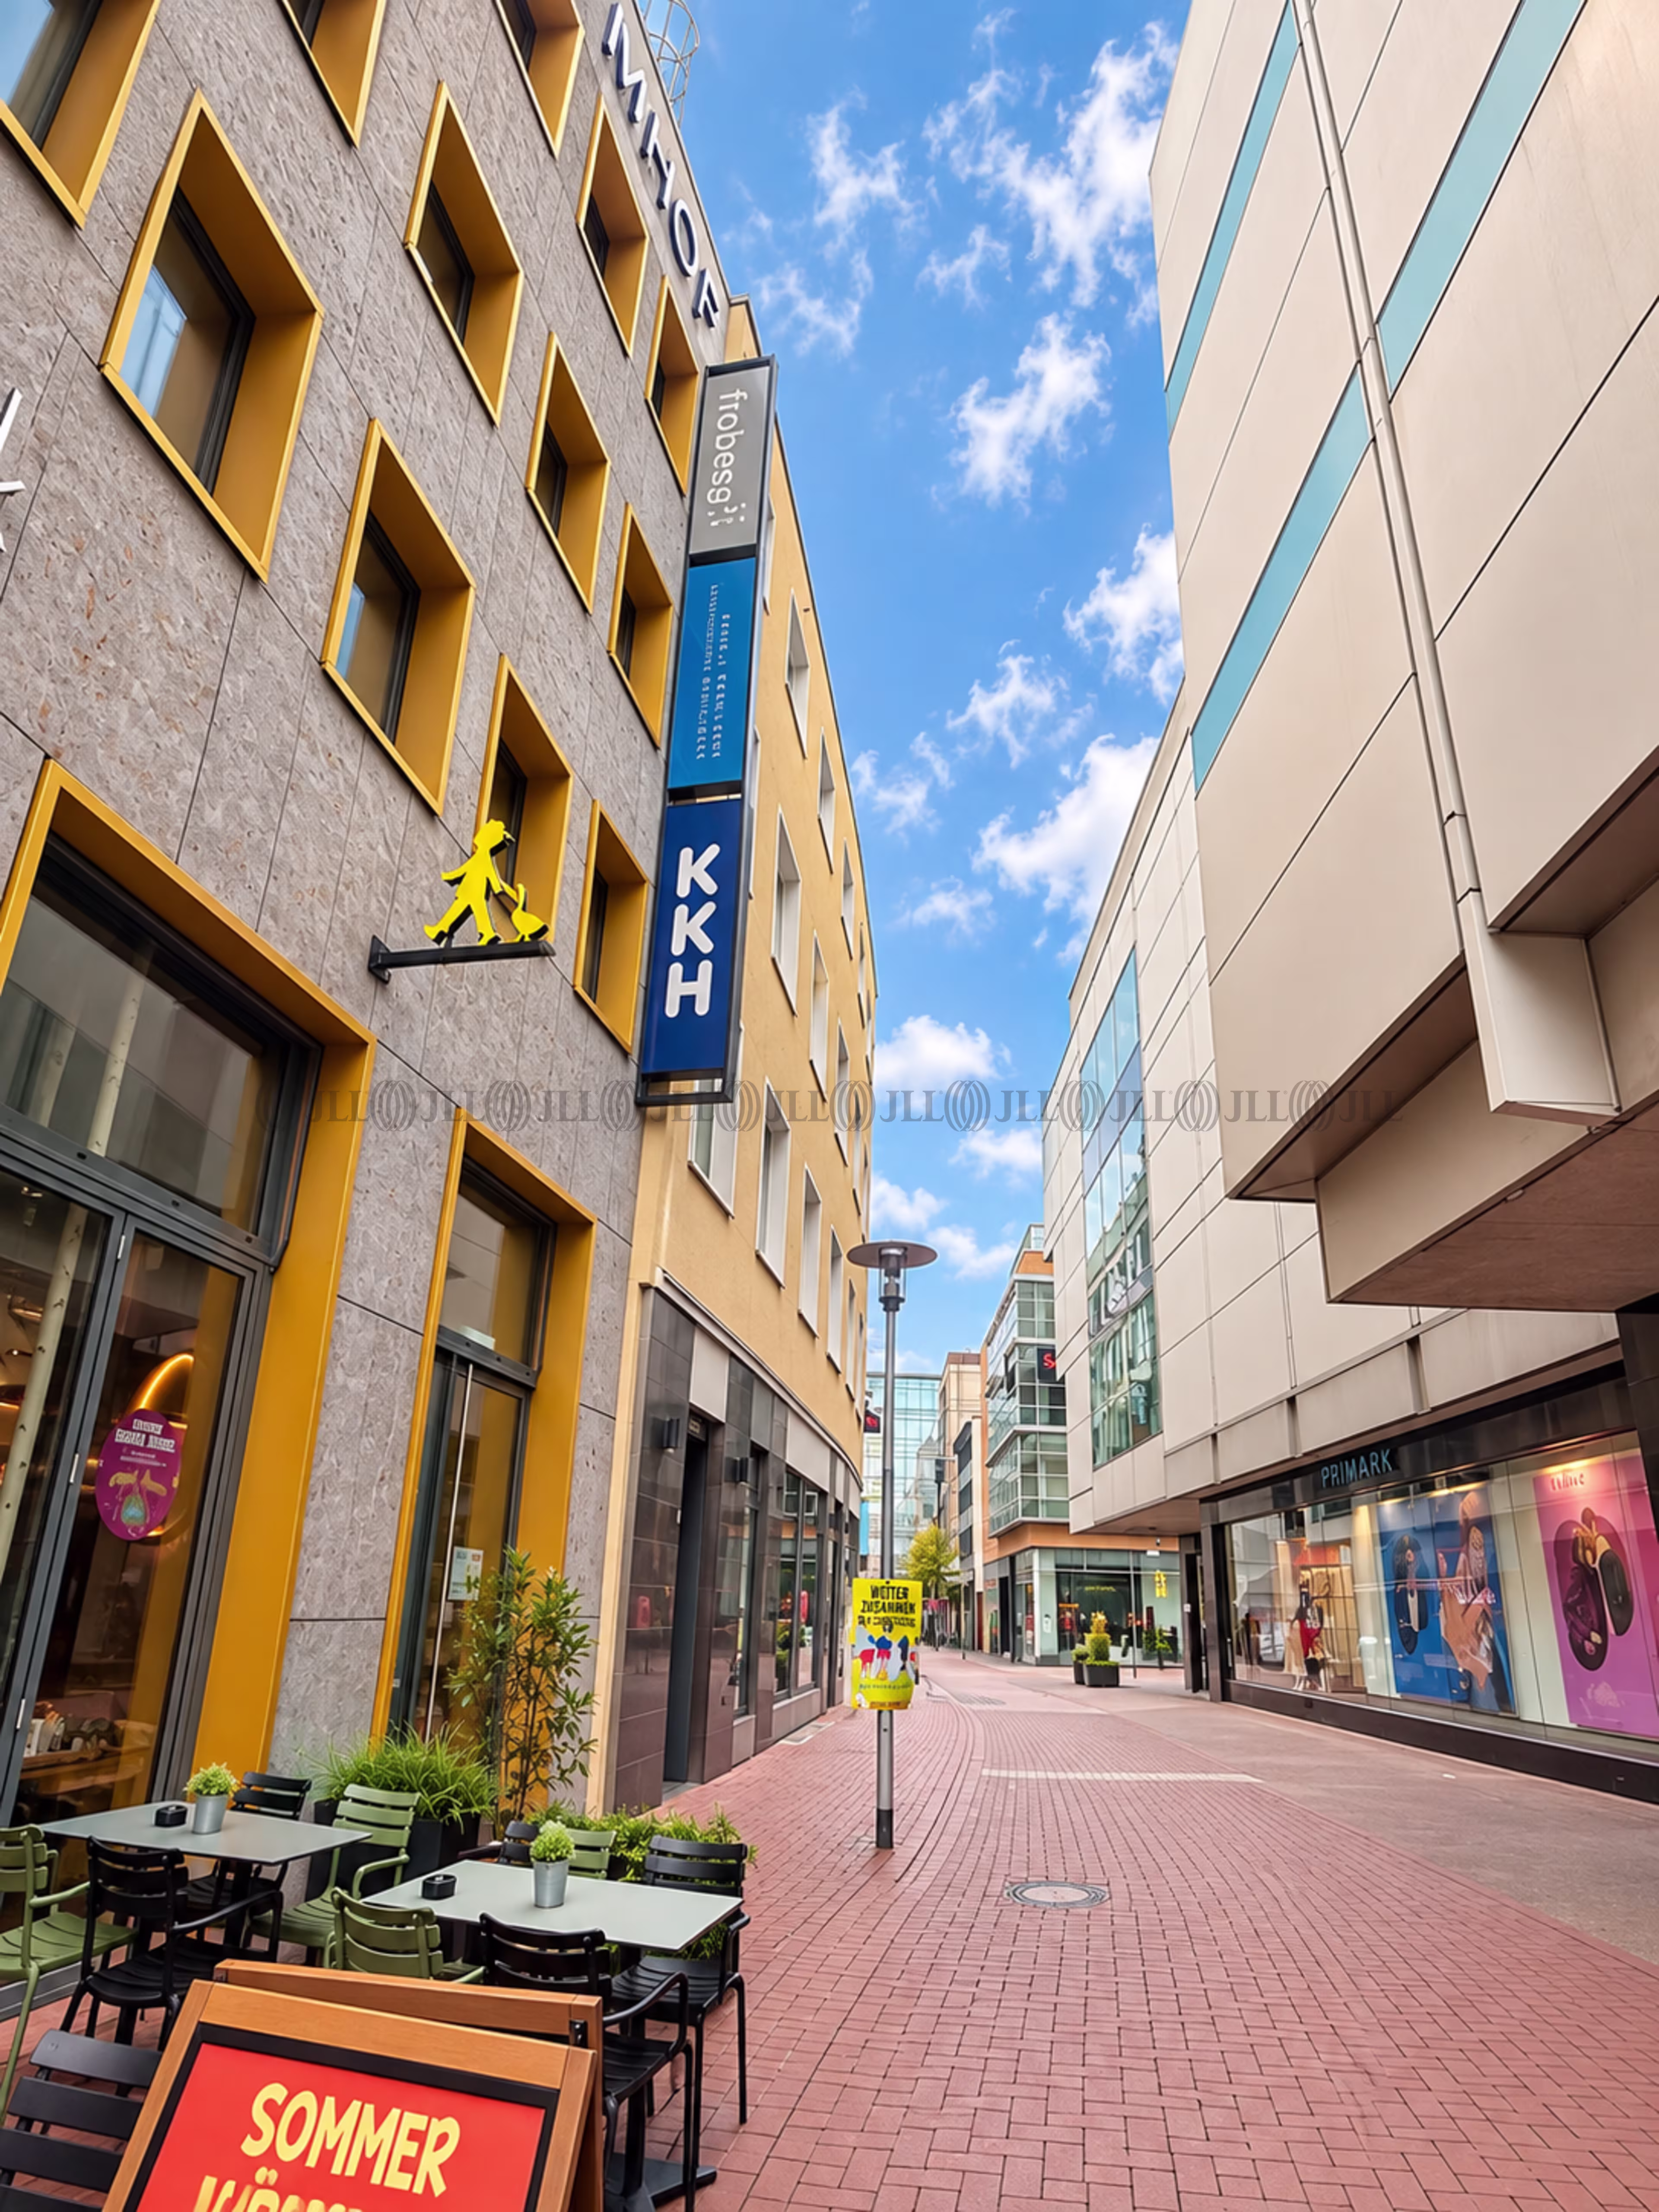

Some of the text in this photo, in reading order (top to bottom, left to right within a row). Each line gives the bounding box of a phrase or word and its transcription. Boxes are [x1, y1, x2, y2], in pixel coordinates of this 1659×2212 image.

[664, 843, 721, 1018] KKH
[1320, 1448, 1392, 1488] PRIMARK
[241, 2082, 461, 2198] SOMMER
